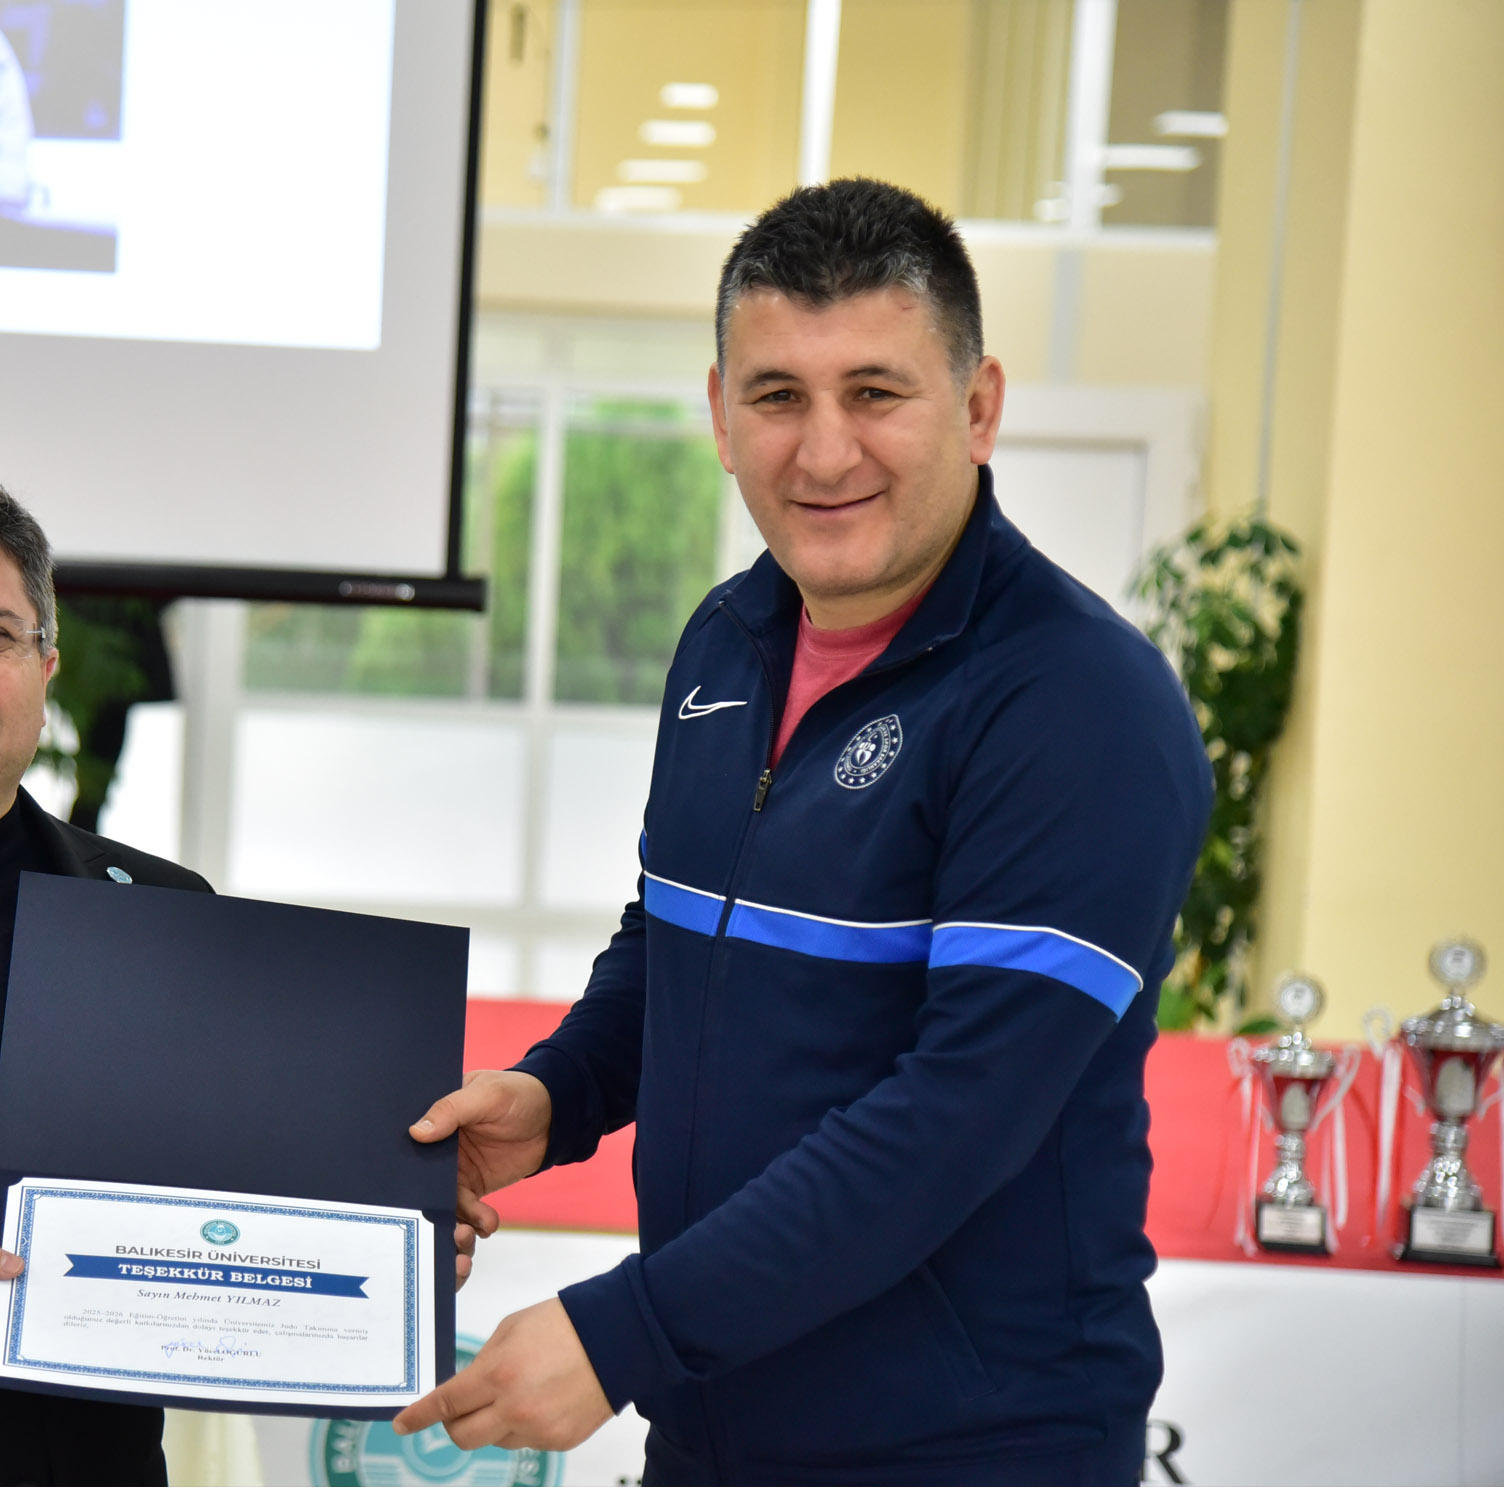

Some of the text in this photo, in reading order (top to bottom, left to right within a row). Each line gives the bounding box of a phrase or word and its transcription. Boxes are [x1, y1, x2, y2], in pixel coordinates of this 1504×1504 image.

[115, 1245, 321, 1270] BALIKESİR ÜNİVERSİTESİ
[118, 1263, 312, 1288] TEŞEKKÜR BELGESİ
[137, 1288, 281, 1307] Sayın Mehmet YILMAZ
